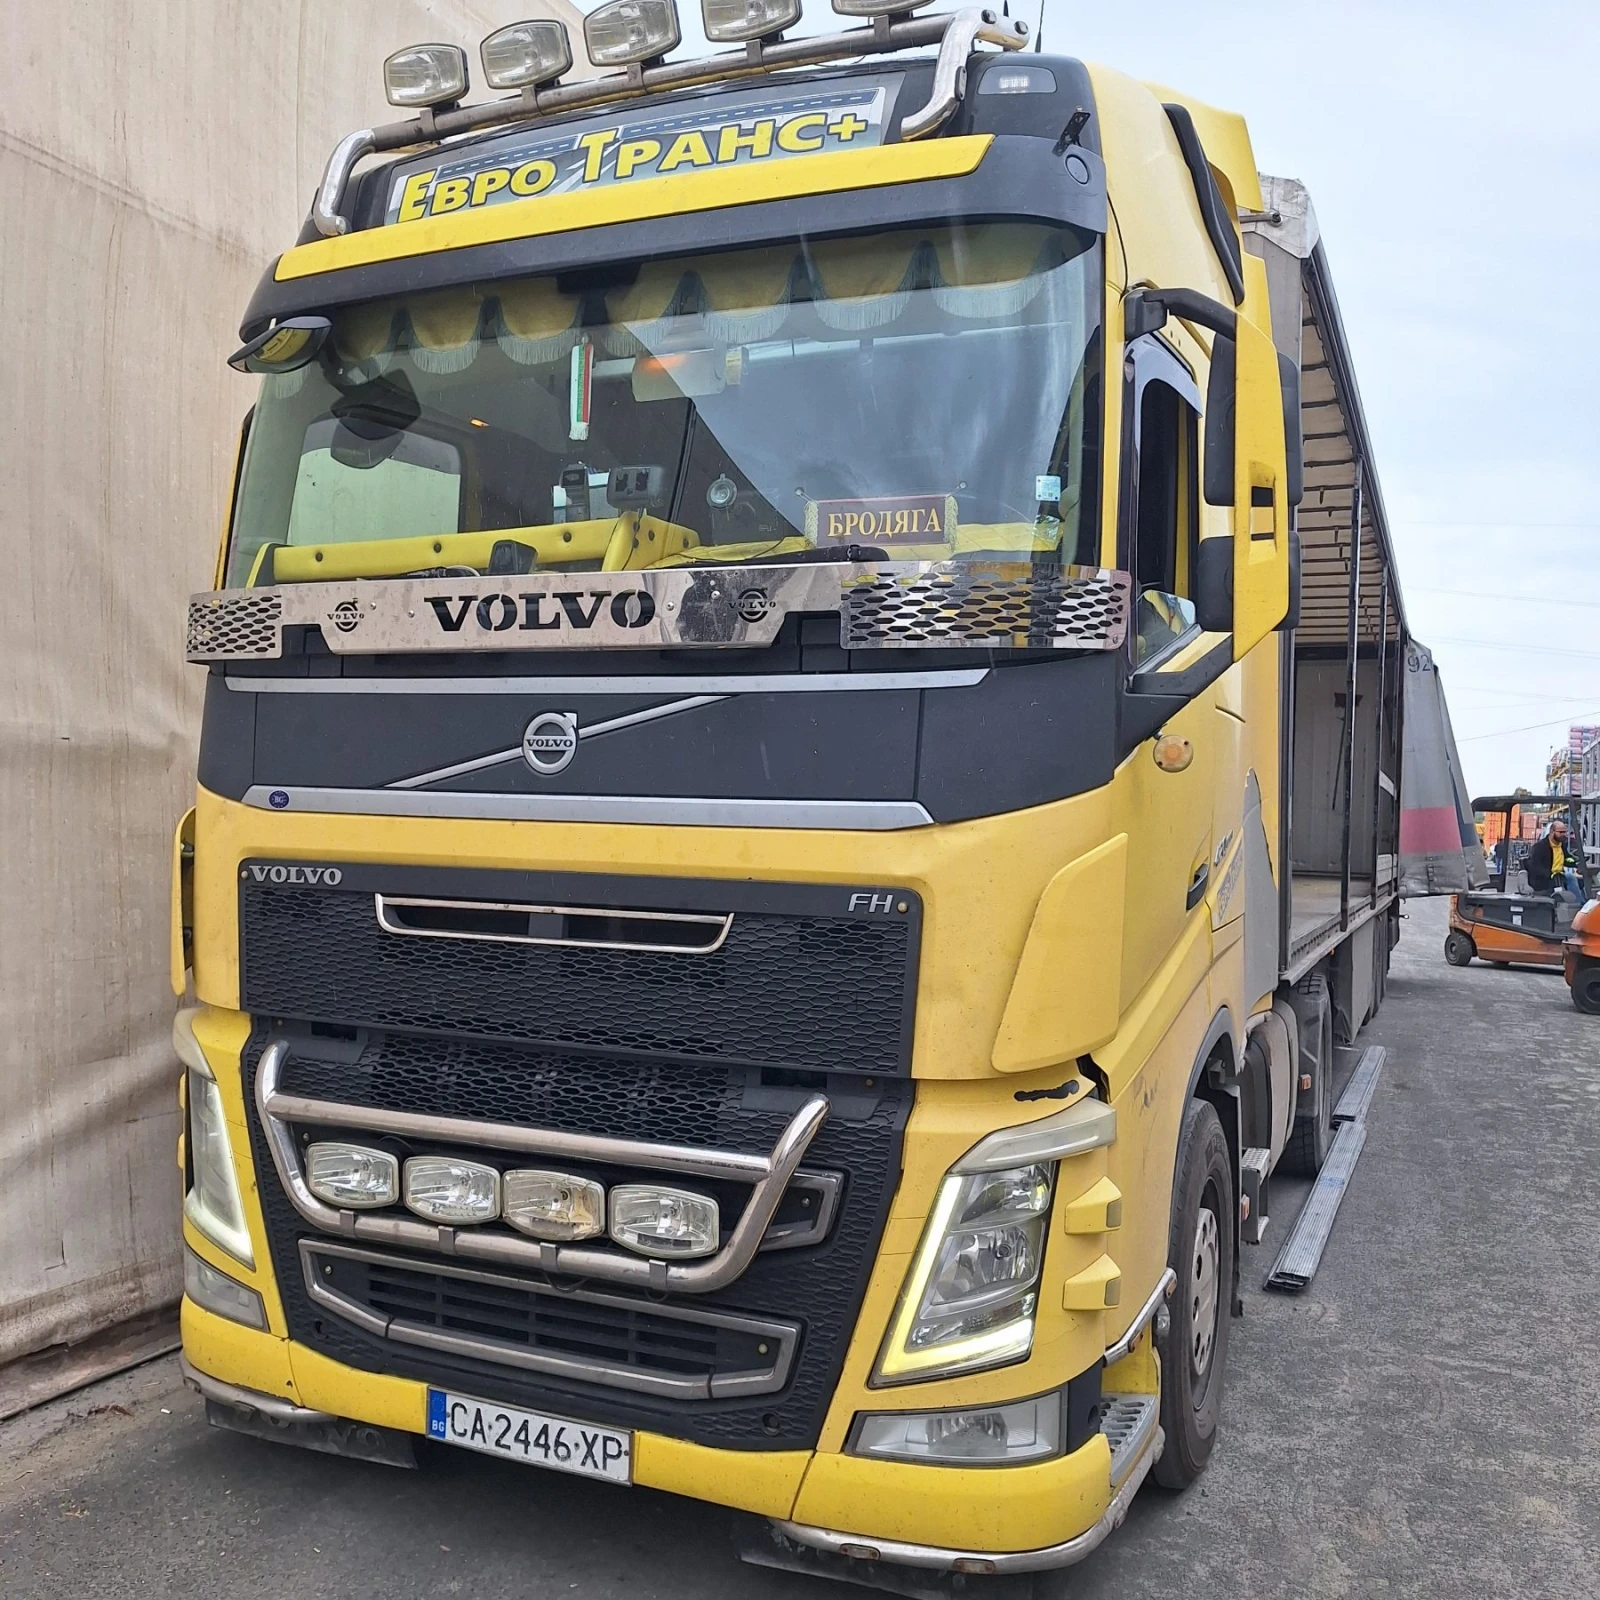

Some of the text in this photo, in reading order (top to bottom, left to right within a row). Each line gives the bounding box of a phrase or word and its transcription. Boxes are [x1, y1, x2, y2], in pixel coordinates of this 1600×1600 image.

[827, 508, 942, 539] БРОДЯГА
[424, 589, 656, 631] VOLVO
[728, 601, 776, 609] VOLVO
[526, 739, 573, 748] VOLVO
[248, 865, 342, 886] VOLVO
[848, 893, 894, 913] FH
[432, 1419, 445, 1433] BG
[495, 1414, 571, 1462] 2446
